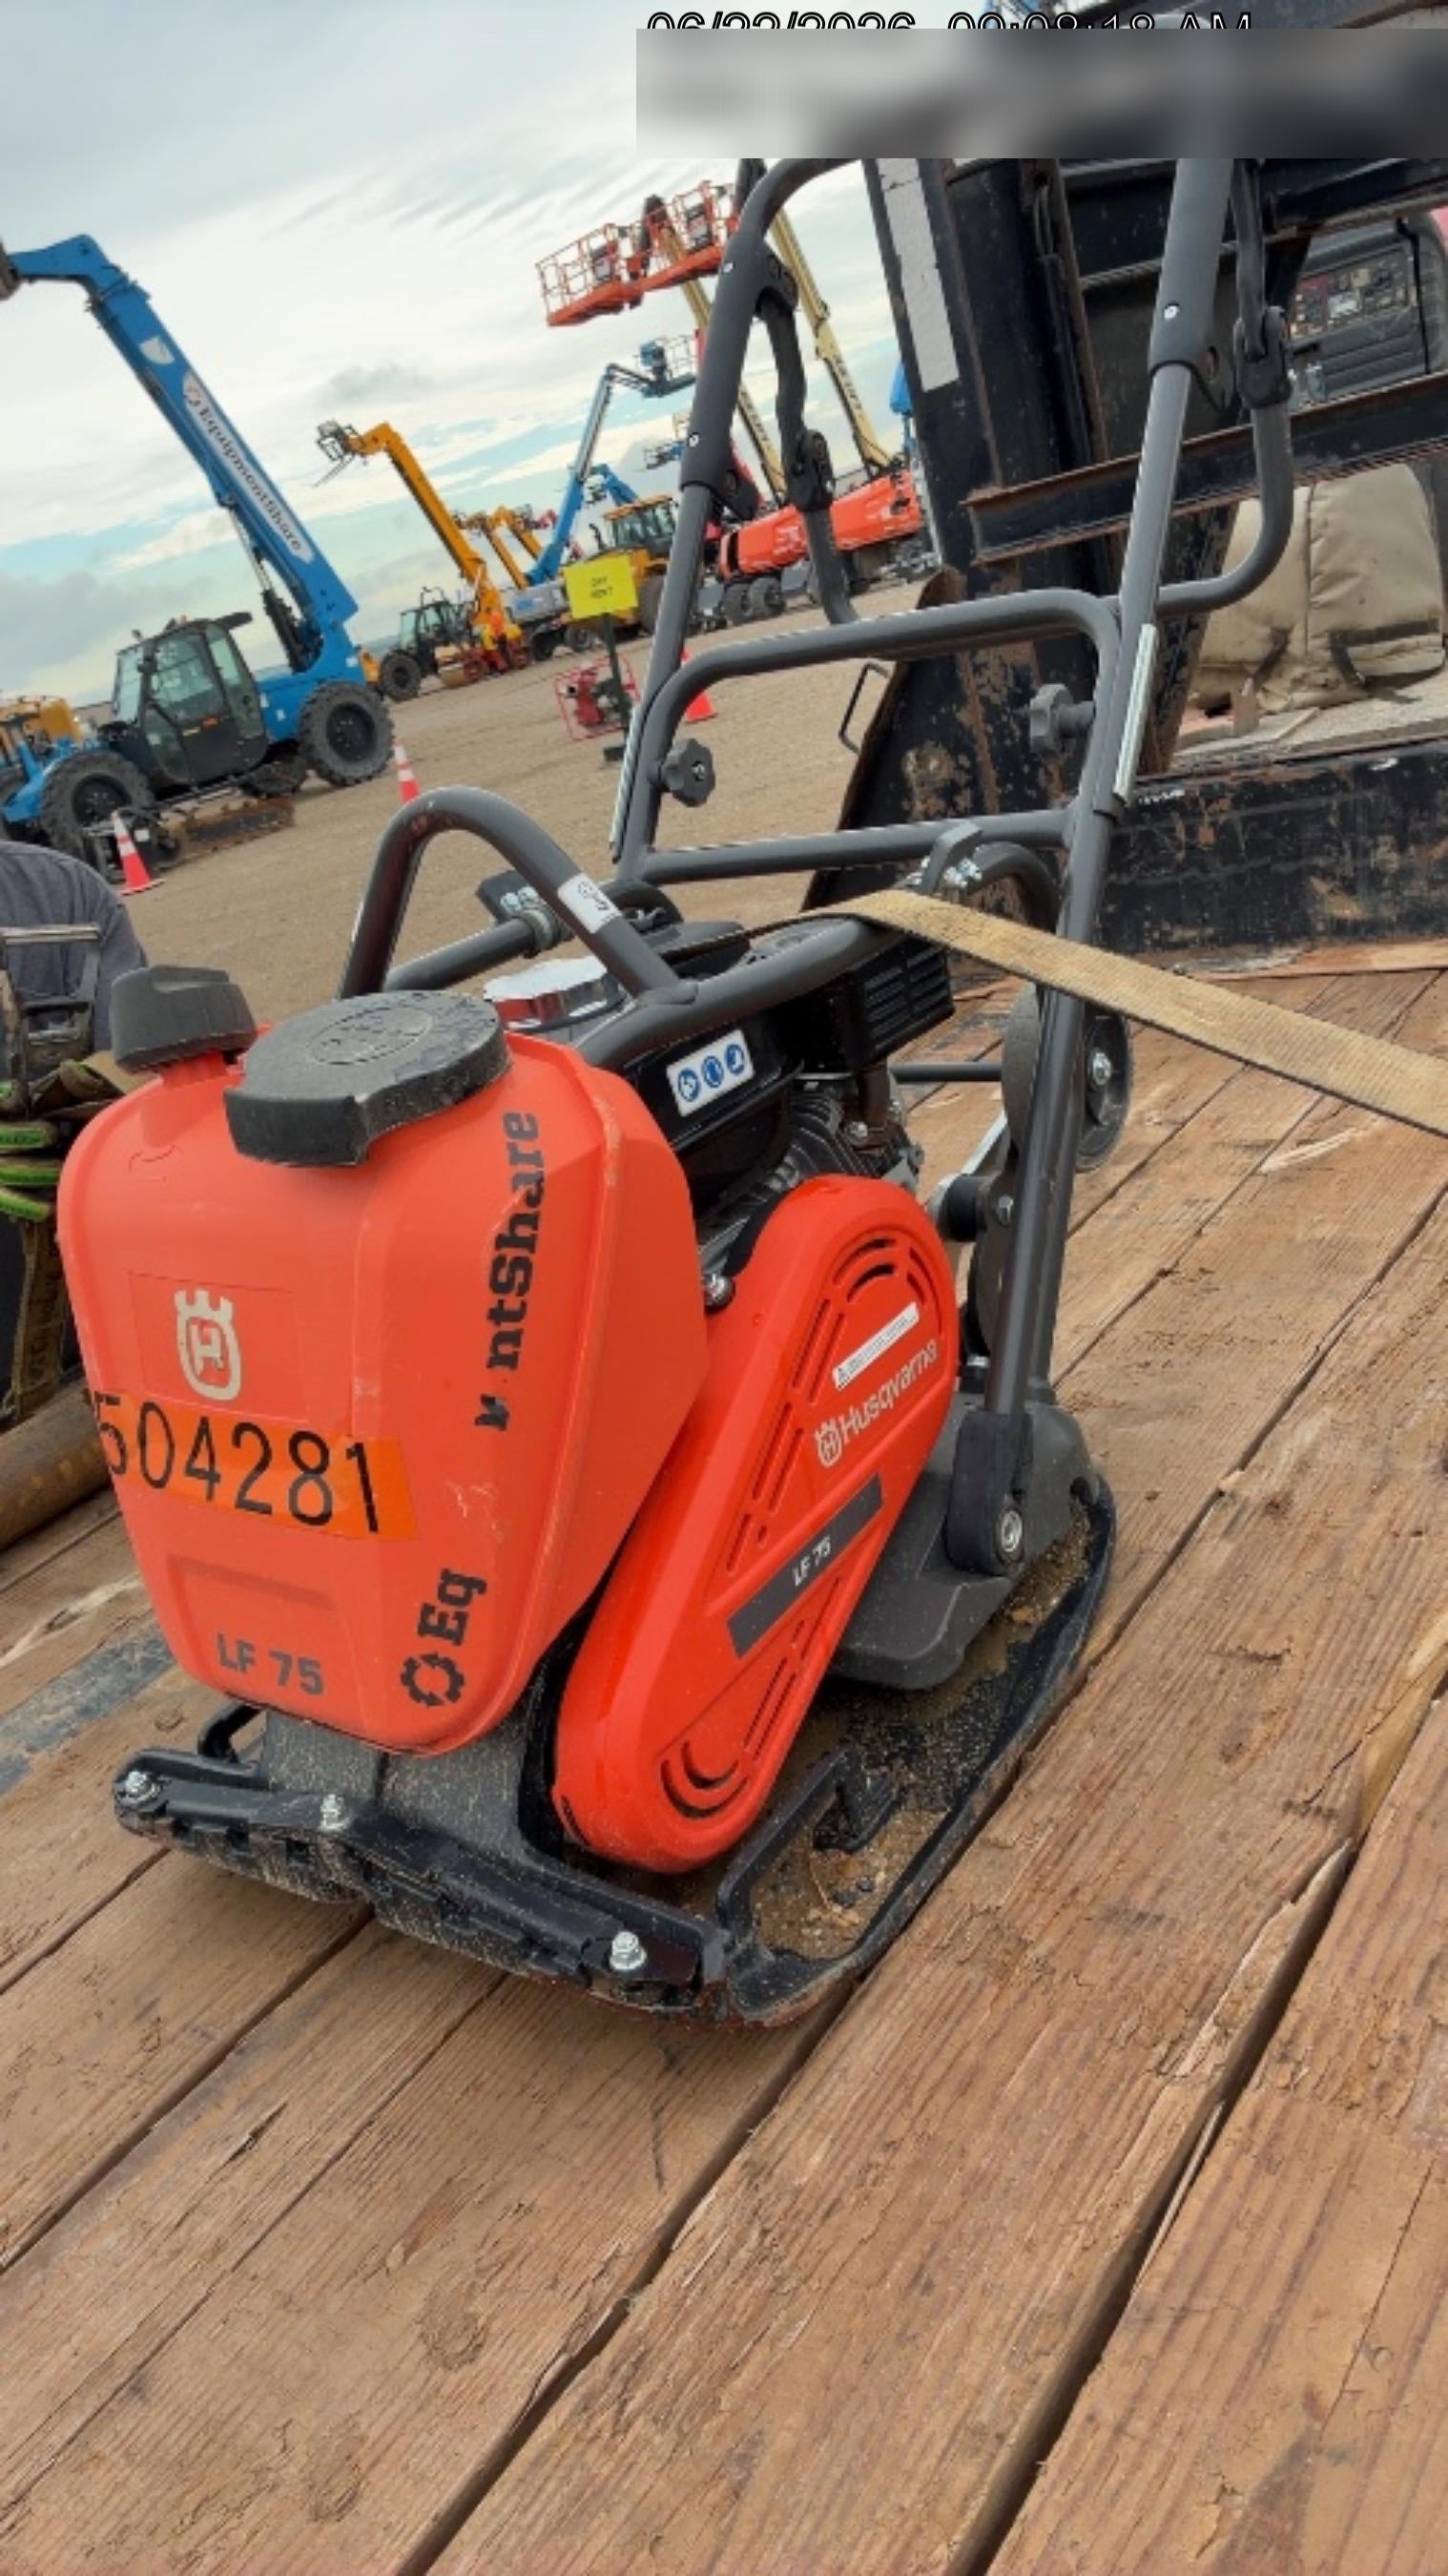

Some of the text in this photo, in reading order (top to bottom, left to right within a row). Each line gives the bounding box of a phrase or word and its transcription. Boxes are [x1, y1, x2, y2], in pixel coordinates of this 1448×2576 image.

[838, 1339, 938, 1446] Husqvarna
[793, 1534, 832, 1588] LF 75
[217, 1631, 324, 1696] LF 75
